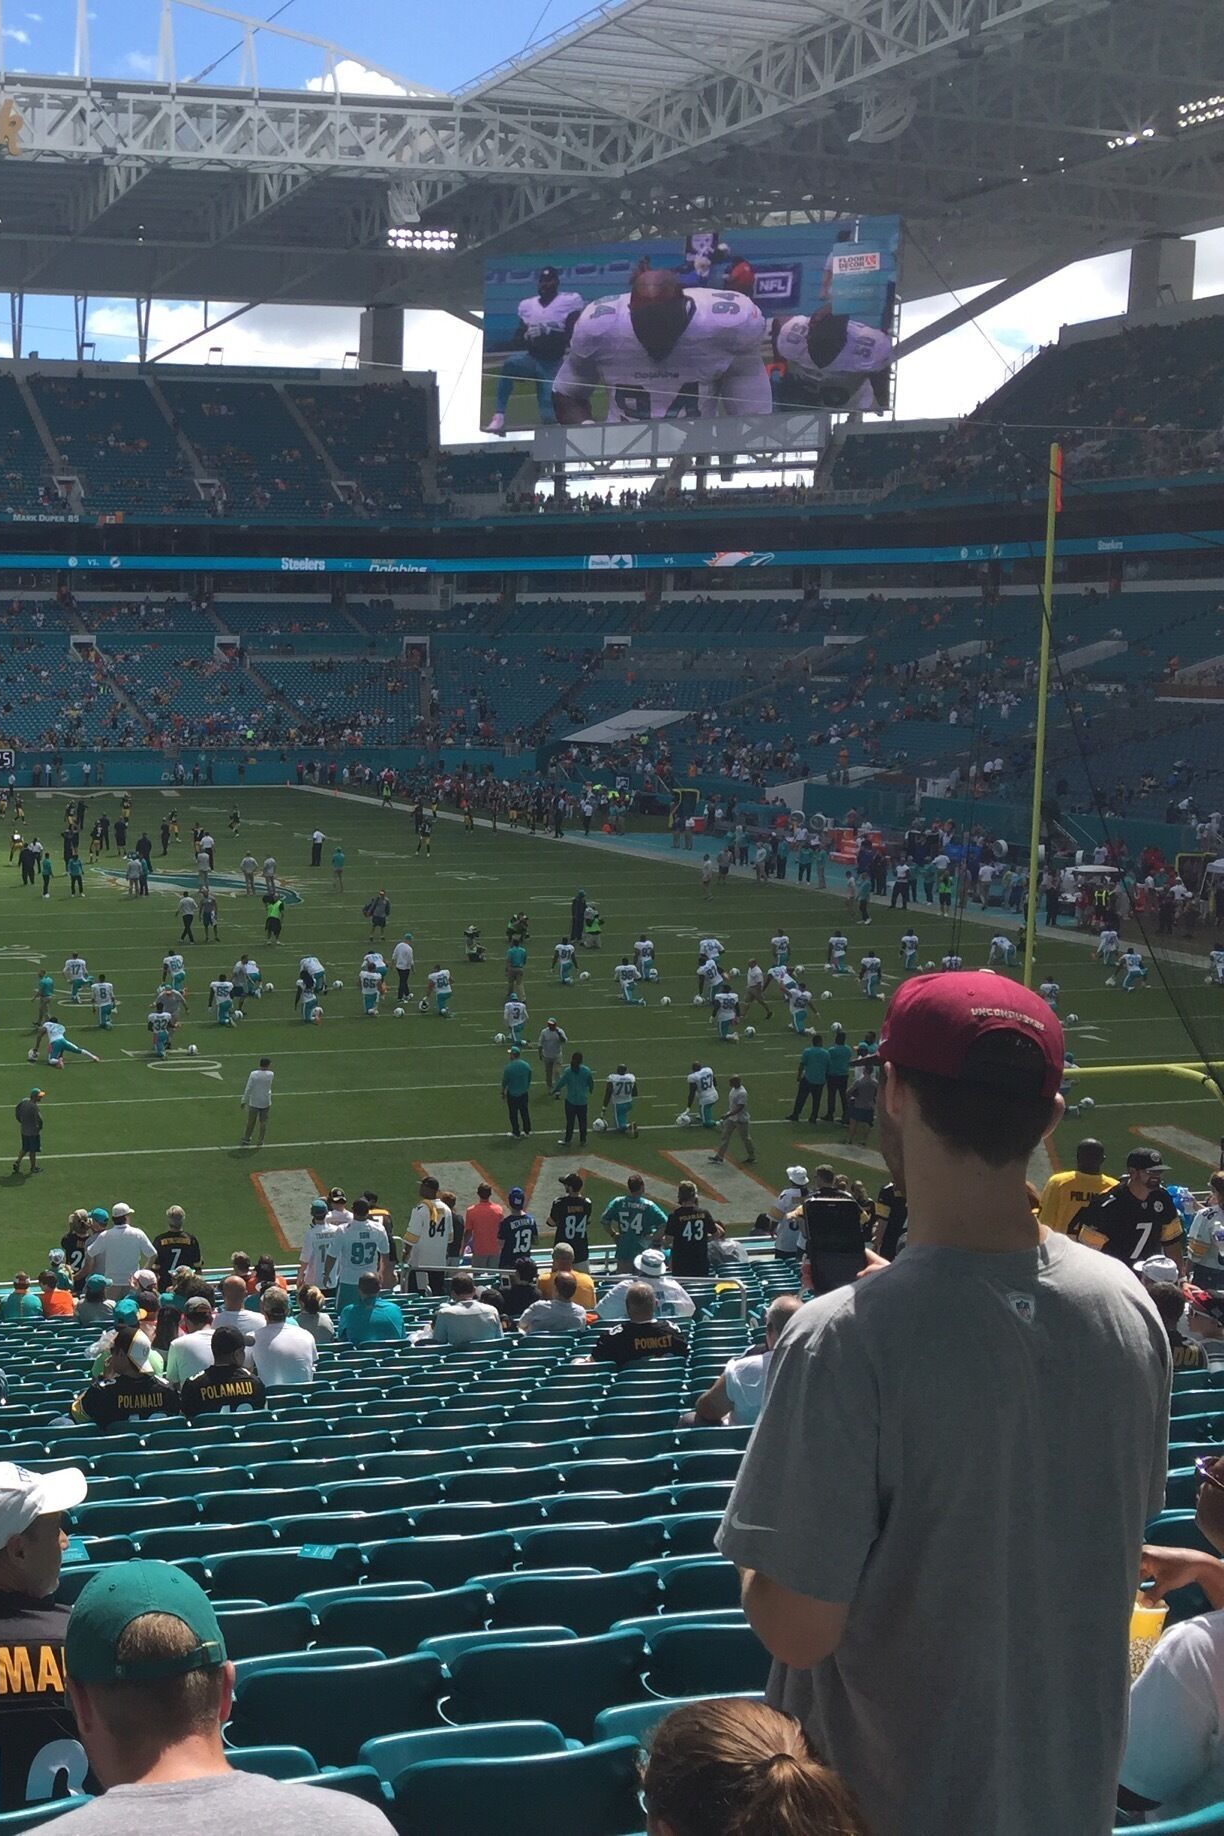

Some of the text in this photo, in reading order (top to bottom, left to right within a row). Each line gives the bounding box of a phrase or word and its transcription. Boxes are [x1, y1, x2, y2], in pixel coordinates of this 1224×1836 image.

[759, 280, 785, 291] NFL
[39, 513, 65, 523] DUPER
[281, 557, 325, 571] Steelers
[71, 964, 81, 976] 17
[99, 988, 107, 999] 8
[513, 1007, 520, 1020] 3
[154, 1019, 168, 1031] 32
[616, 1081, 633, 1095] 70
[700, 1074, 713, 1091] 67
[428, 1215, 446, 1238] 84
[565, 1214, 587, 1239] 84
[618, 1211, 643, 1235] 54
[682, 1219, 704, 1241] 43
[513, 1229, 531, 1254] 13
[1130, 1222, 1153, 1260] 7
[171, 1248, 182, 1271] 7
[351, 1242, 376, 1265] 93
[200, 1381, 253, 1400] POLAMALU
[117, 1392, 163, 1408] POLAMALU
